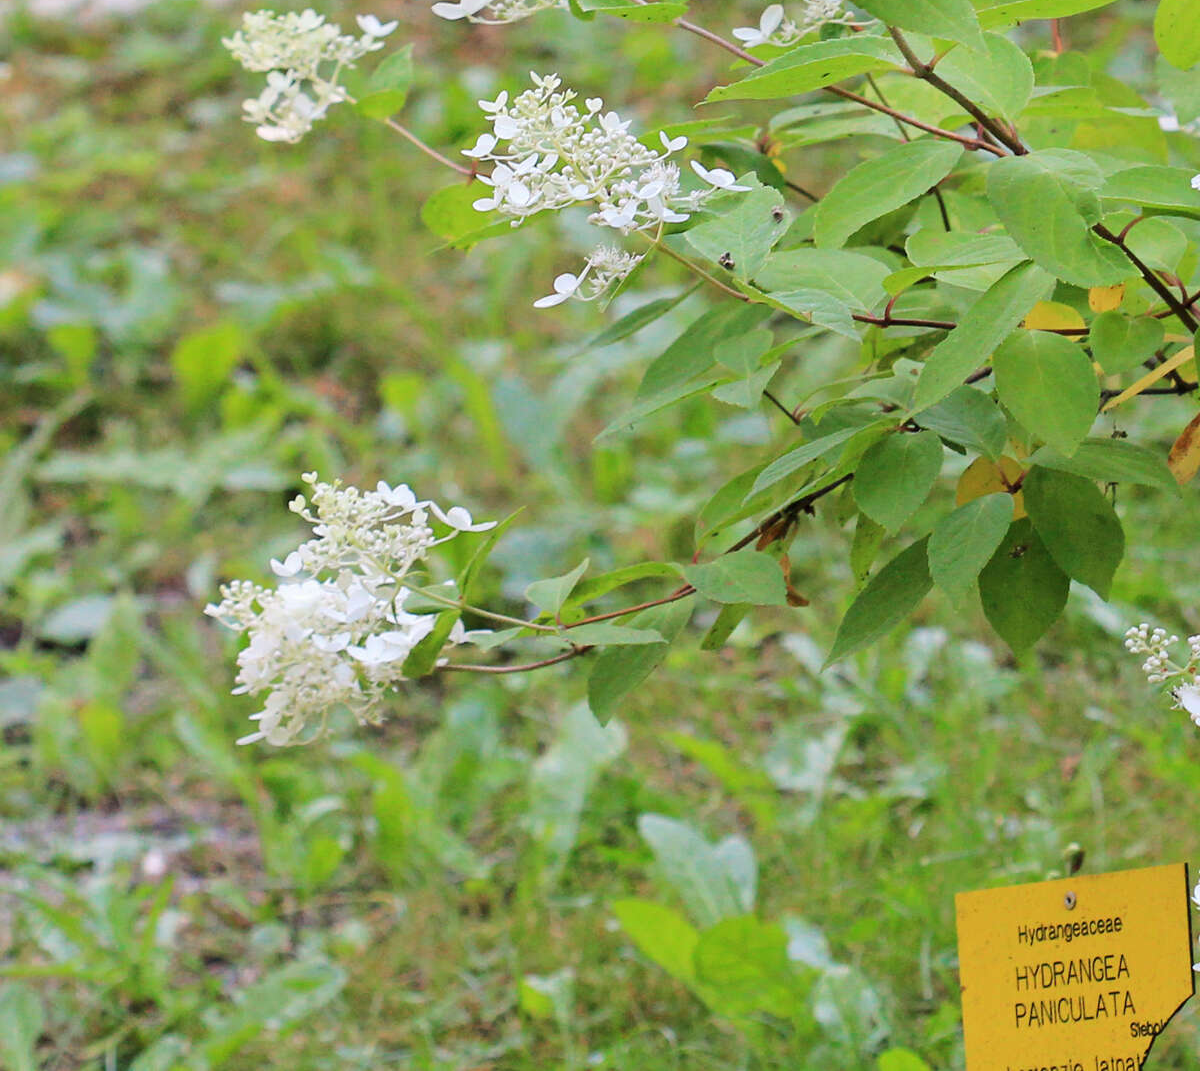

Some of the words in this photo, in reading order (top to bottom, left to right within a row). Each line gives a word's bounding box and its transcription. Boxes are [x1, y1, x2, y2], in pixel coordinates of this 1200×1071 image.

[1018, 917, 1122, 946] Hydrangeaceae
[1016, 954, 1130, 991] HYDRANGEA
[1015, 990, 1136, 1028] PANICULATA
